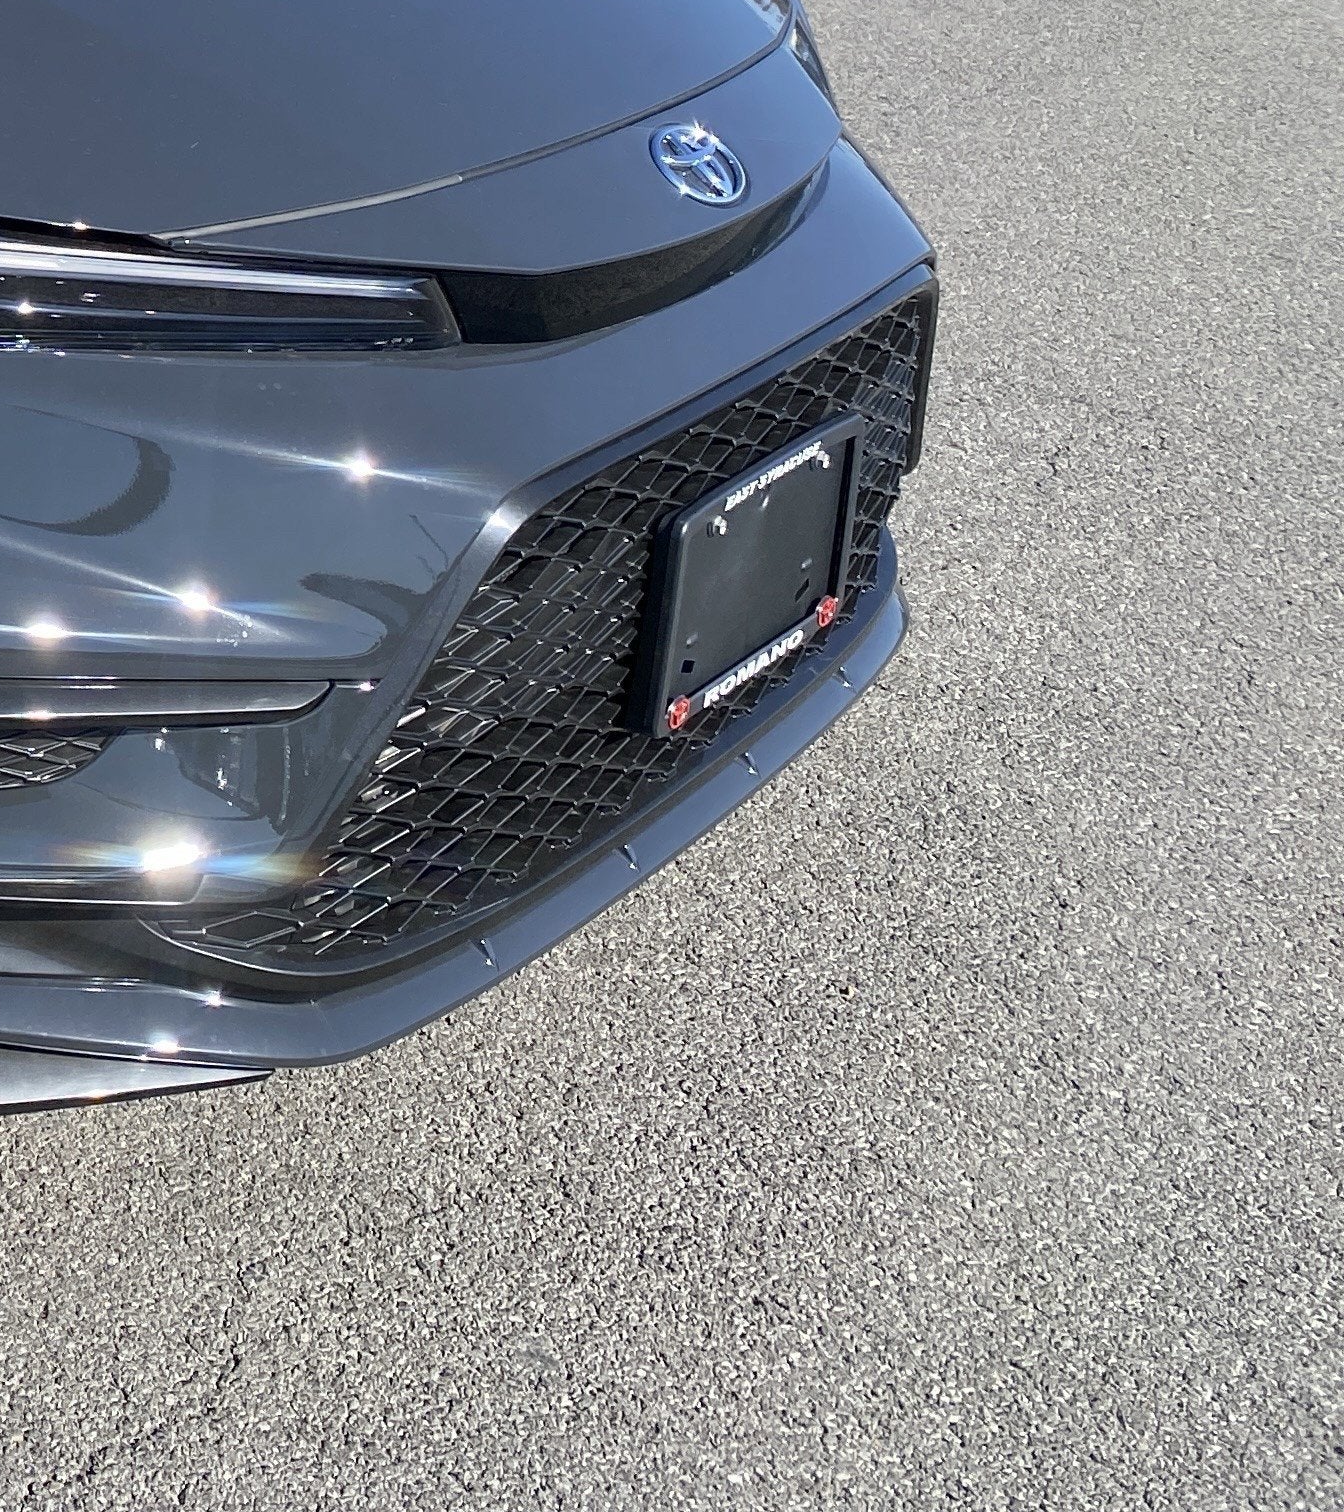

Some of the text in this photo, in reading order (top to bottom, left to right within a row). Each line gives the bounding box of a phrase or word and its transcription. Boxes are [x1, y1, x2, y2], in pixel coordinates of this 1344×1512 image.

[724, 440, 823, 511] EAST SYRACUSE
[703, 629, 804, 709] ROMANO
